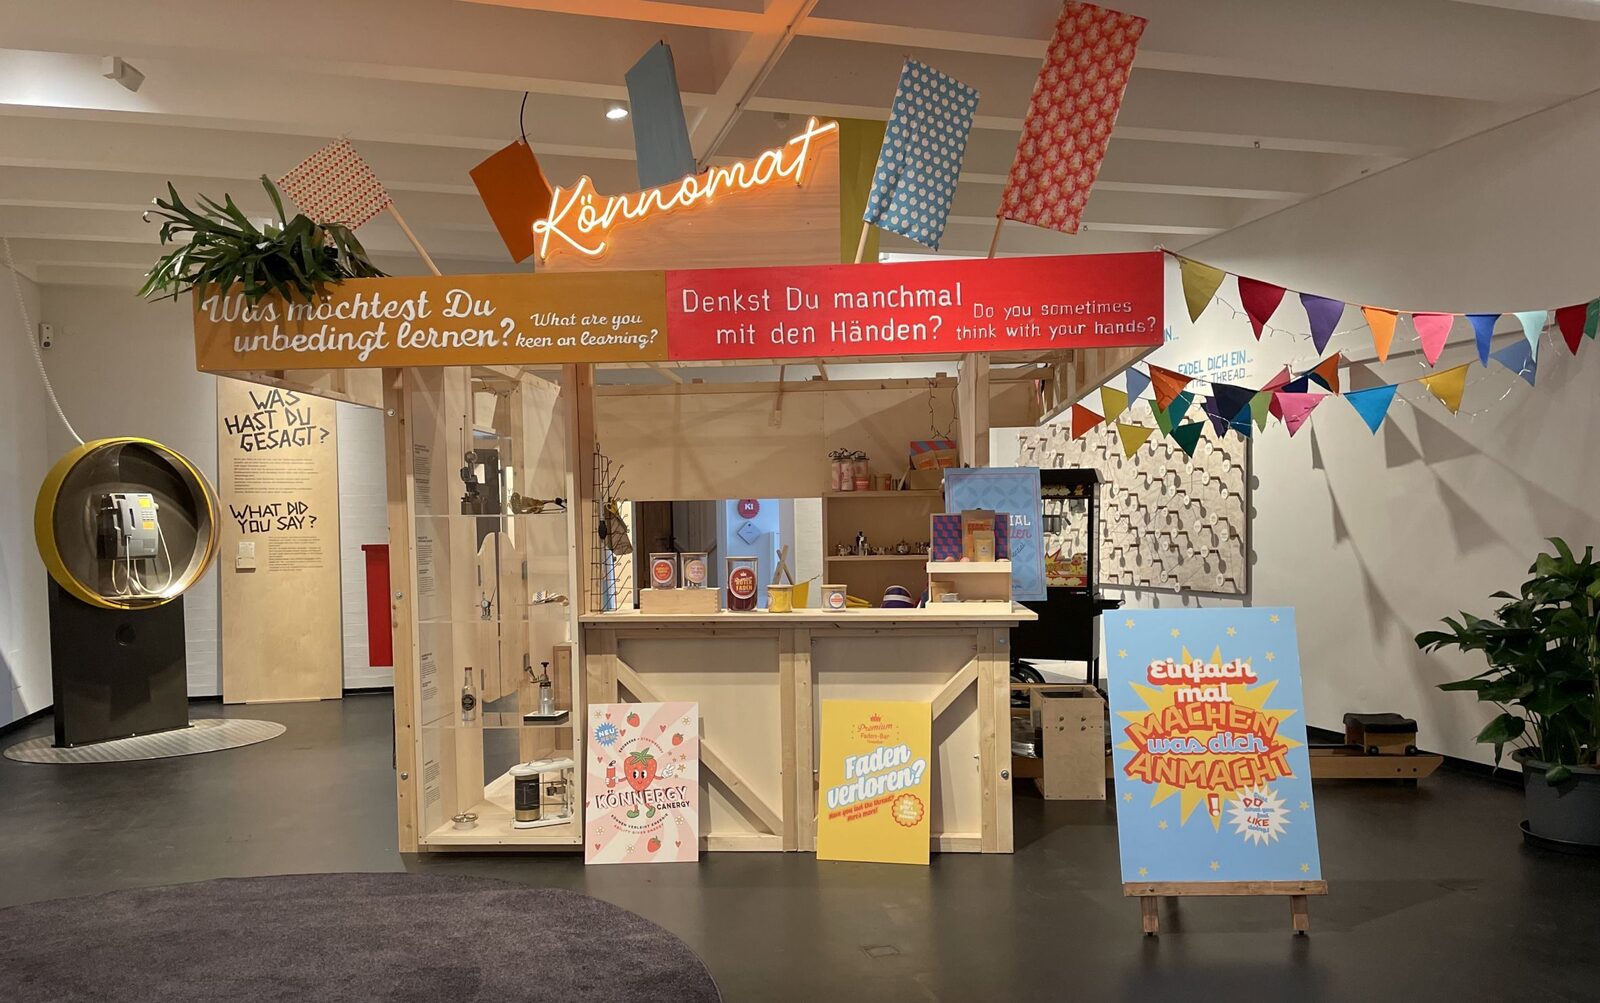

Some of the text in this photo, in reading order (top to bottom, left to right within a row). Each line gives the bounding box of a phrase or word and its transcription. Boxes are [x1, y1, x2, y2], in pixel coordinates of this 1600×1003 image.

[533, 117, 837, 258] Könnomat
[202, 288, 496, 323] Was möchtest Du
[682, 282, 962, 315] Denkst Du manchmal
[973, 301, 1132, 319] Do you sometimes
[530, 312, 643, 331] What are you
[716, 316, 942, 345] mit den Händen?
[956, 315, 1156, 341] think with your hands?
[233, 317, 515, 362] unbedingt lernen?
[516, 328, 659, 348] keen on learning?
[1207, 354, 1229, 371] DICH
[1191, 375, 1208, 388] THE
[249, 388, 301, 410] WAS
[224, 407, 311, 435] HAST DU
[229, 501, 309, 519] WHAT DID
[237, 517, 271, 534] YOU
[1148, 658, 1257, 684] Einfach
[1176, 682, 1233, 703] mal
[598, 727, 615, 738] NEU
[1124, 703, 1280, 746] MACHEN
[1147, 732, 1268, 754] was dich
[844, 744, 911, 780] Faden
[1123, 745, 1293, 791] ANMACHT
[827, 759, 926, 808] verloren?
[595, 785, 687, 810] KÖNNERGY
[656, 800, 691, 810] CANERGY
[1243, 797, 1264, 808] DO
[1247, 815, 1270, 827] LIKE
